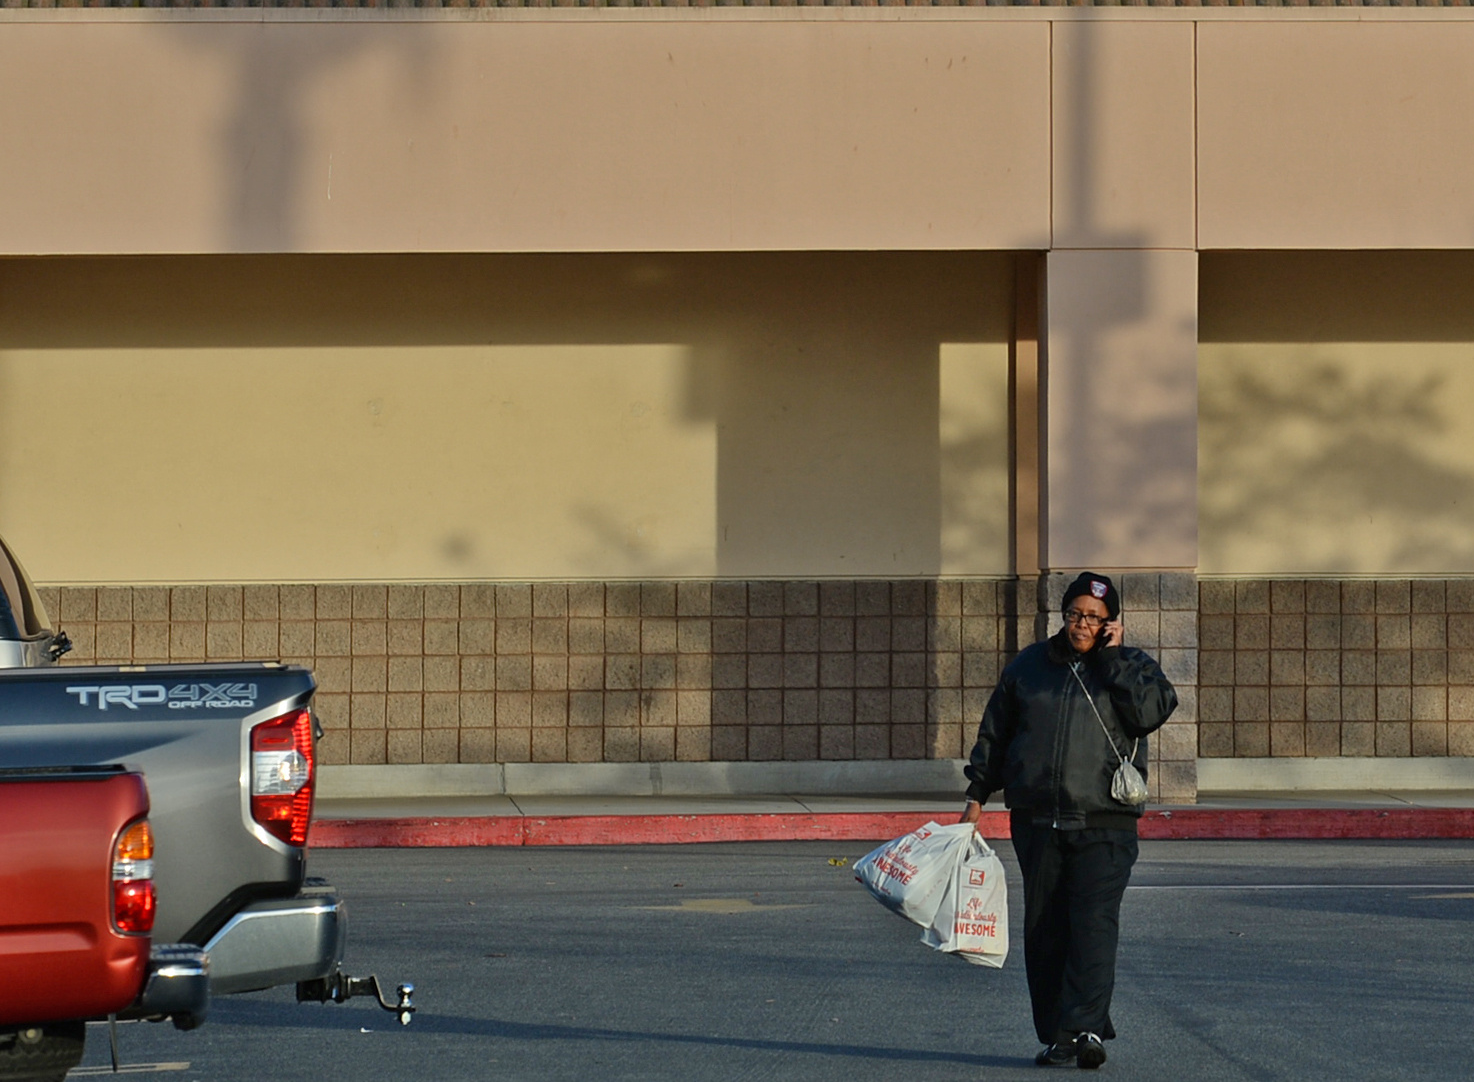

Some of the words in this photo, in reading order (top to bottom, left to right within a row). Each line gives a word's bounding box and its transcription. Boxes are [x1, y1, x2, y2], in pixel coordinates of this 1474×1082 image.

[66, 684, 168, 710] TRD
[168, 700, 203, 709] OFF
[206, 700, 255, 709] ROAD
